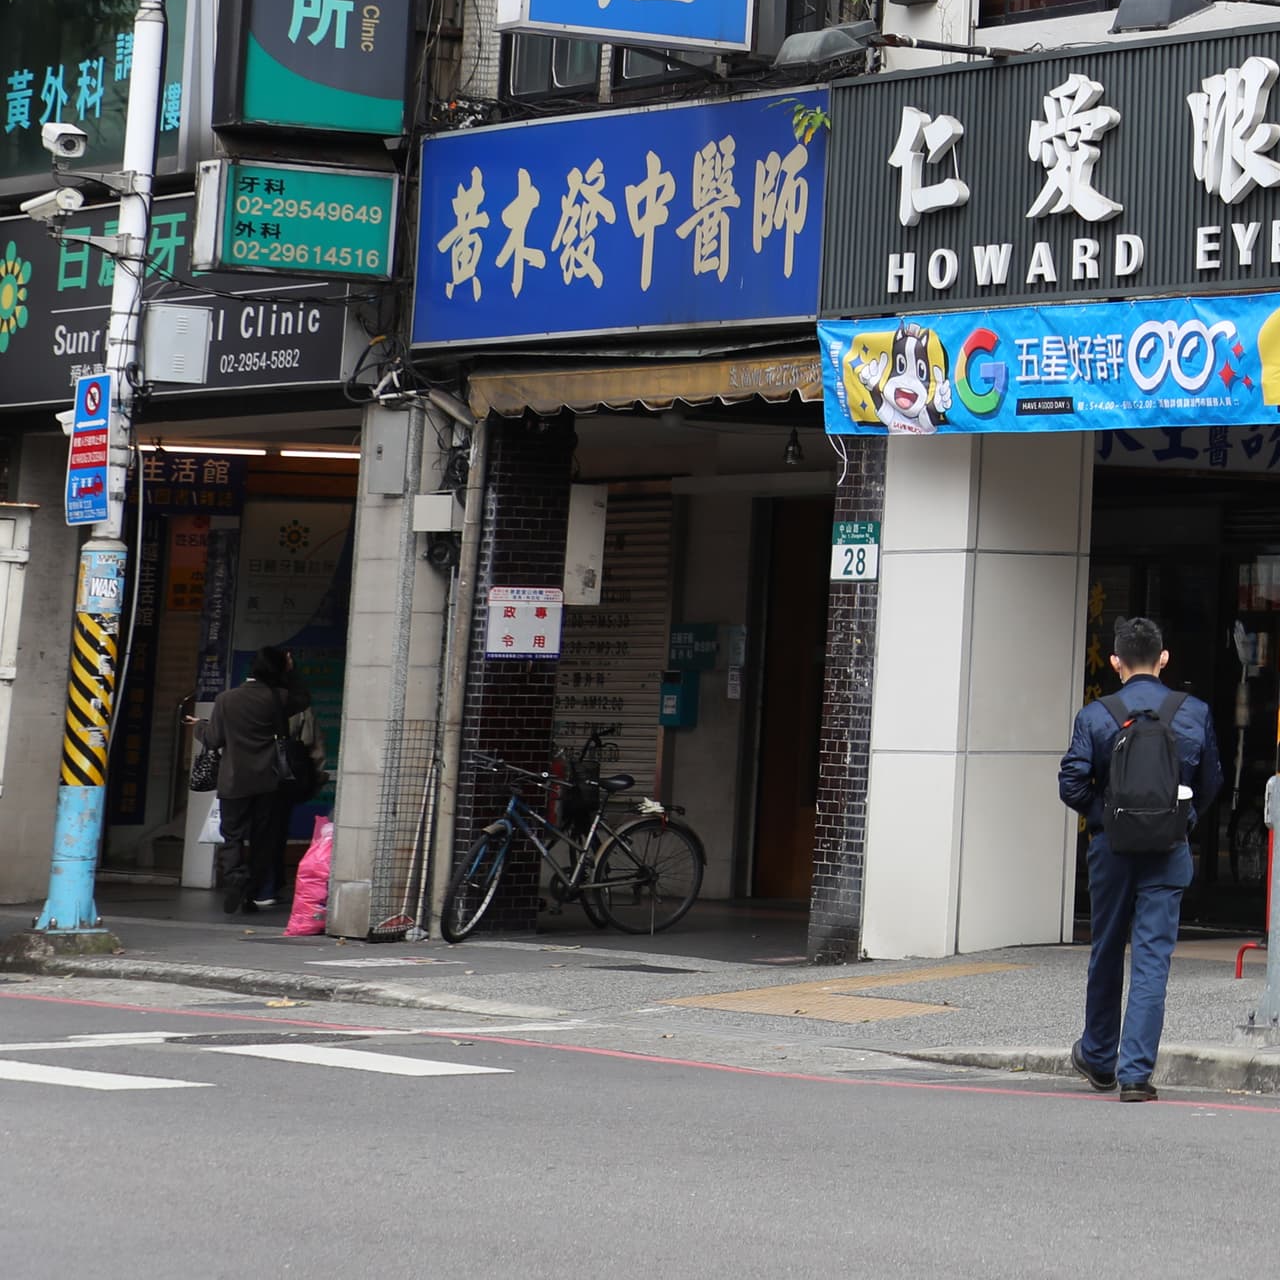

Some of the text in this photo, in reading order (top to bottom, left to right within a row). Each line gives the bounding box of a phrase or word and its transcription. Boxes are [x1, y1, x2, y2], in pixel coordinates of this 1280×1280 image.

[360, 5, 381, 52] Clinic
[4, 56, 105, 134] 黃外科
[238, 175, 286, 196] 牙科
[235, 195, 383, 225] 02-29549649
[437, 134, 809, 302] 黃木發中醫師
[234, 220, 281, 240] 外科
[232, 240, 380, 269] 02-29614516
[886, 233, 1146, 294] HOWARD
[240, 302, 321, 340] Clinic
[53, 320, 110, 356] Sunr
[220, 347, 300, 374] 02-2954-5882
[1014, 333, 1125, 384] 五星好評
[127, 457, 231, 485] 生活館
[843, 547, 866, 576] 28
